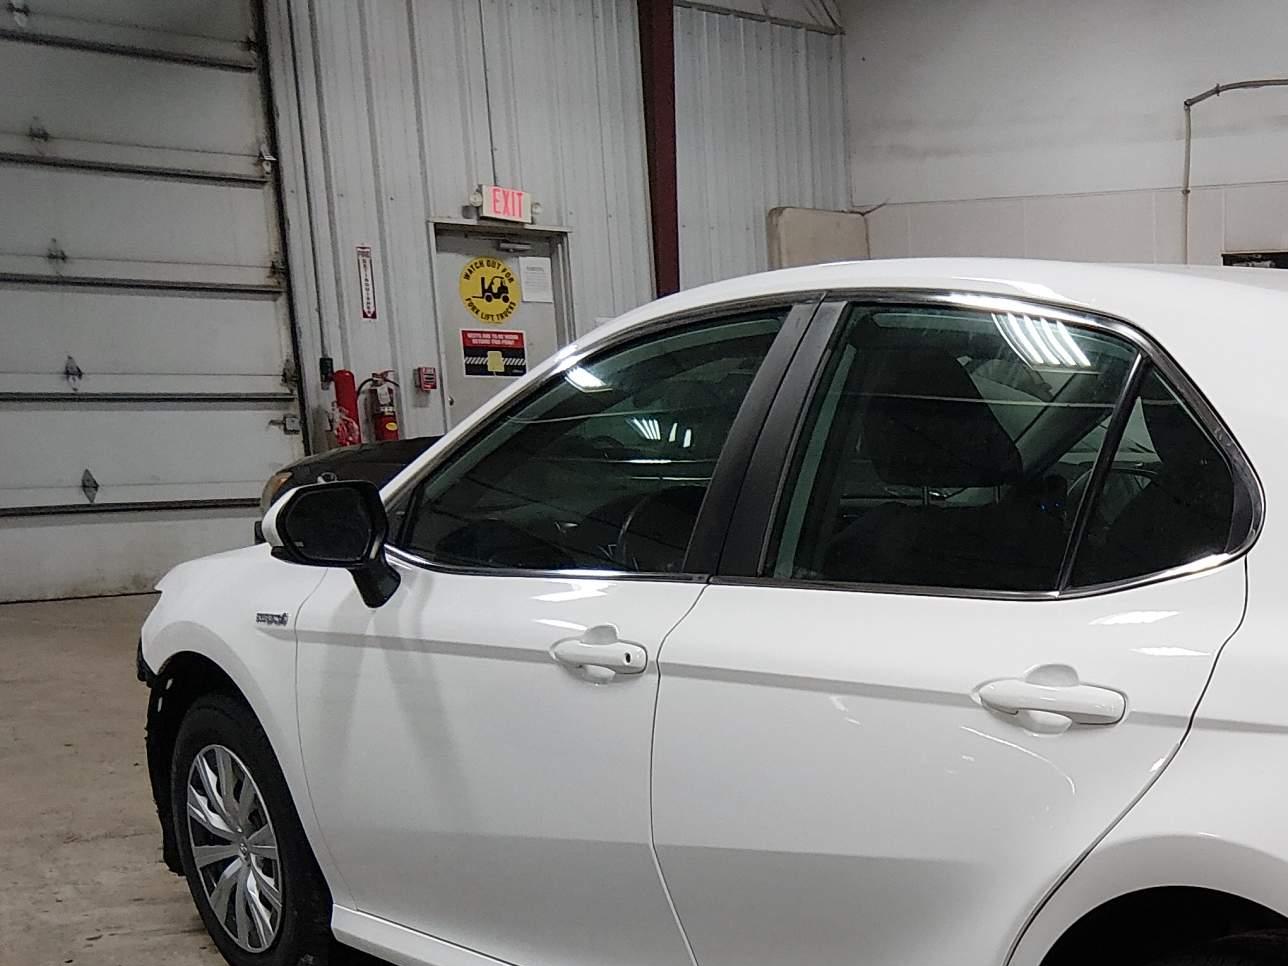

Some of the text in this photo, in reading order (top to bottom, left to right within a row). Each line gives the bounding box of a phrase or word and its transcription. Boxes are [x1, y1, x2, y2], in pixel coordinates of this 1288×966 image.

[493, 188, 523, 218] EXIT
[464, 260, 485, 281] WATCH
[486, 259, 502, 270] OUT
[501, 267, 515, 284] FOR
[465, 297, 517, 322] FORK LIFT TRUCKS
